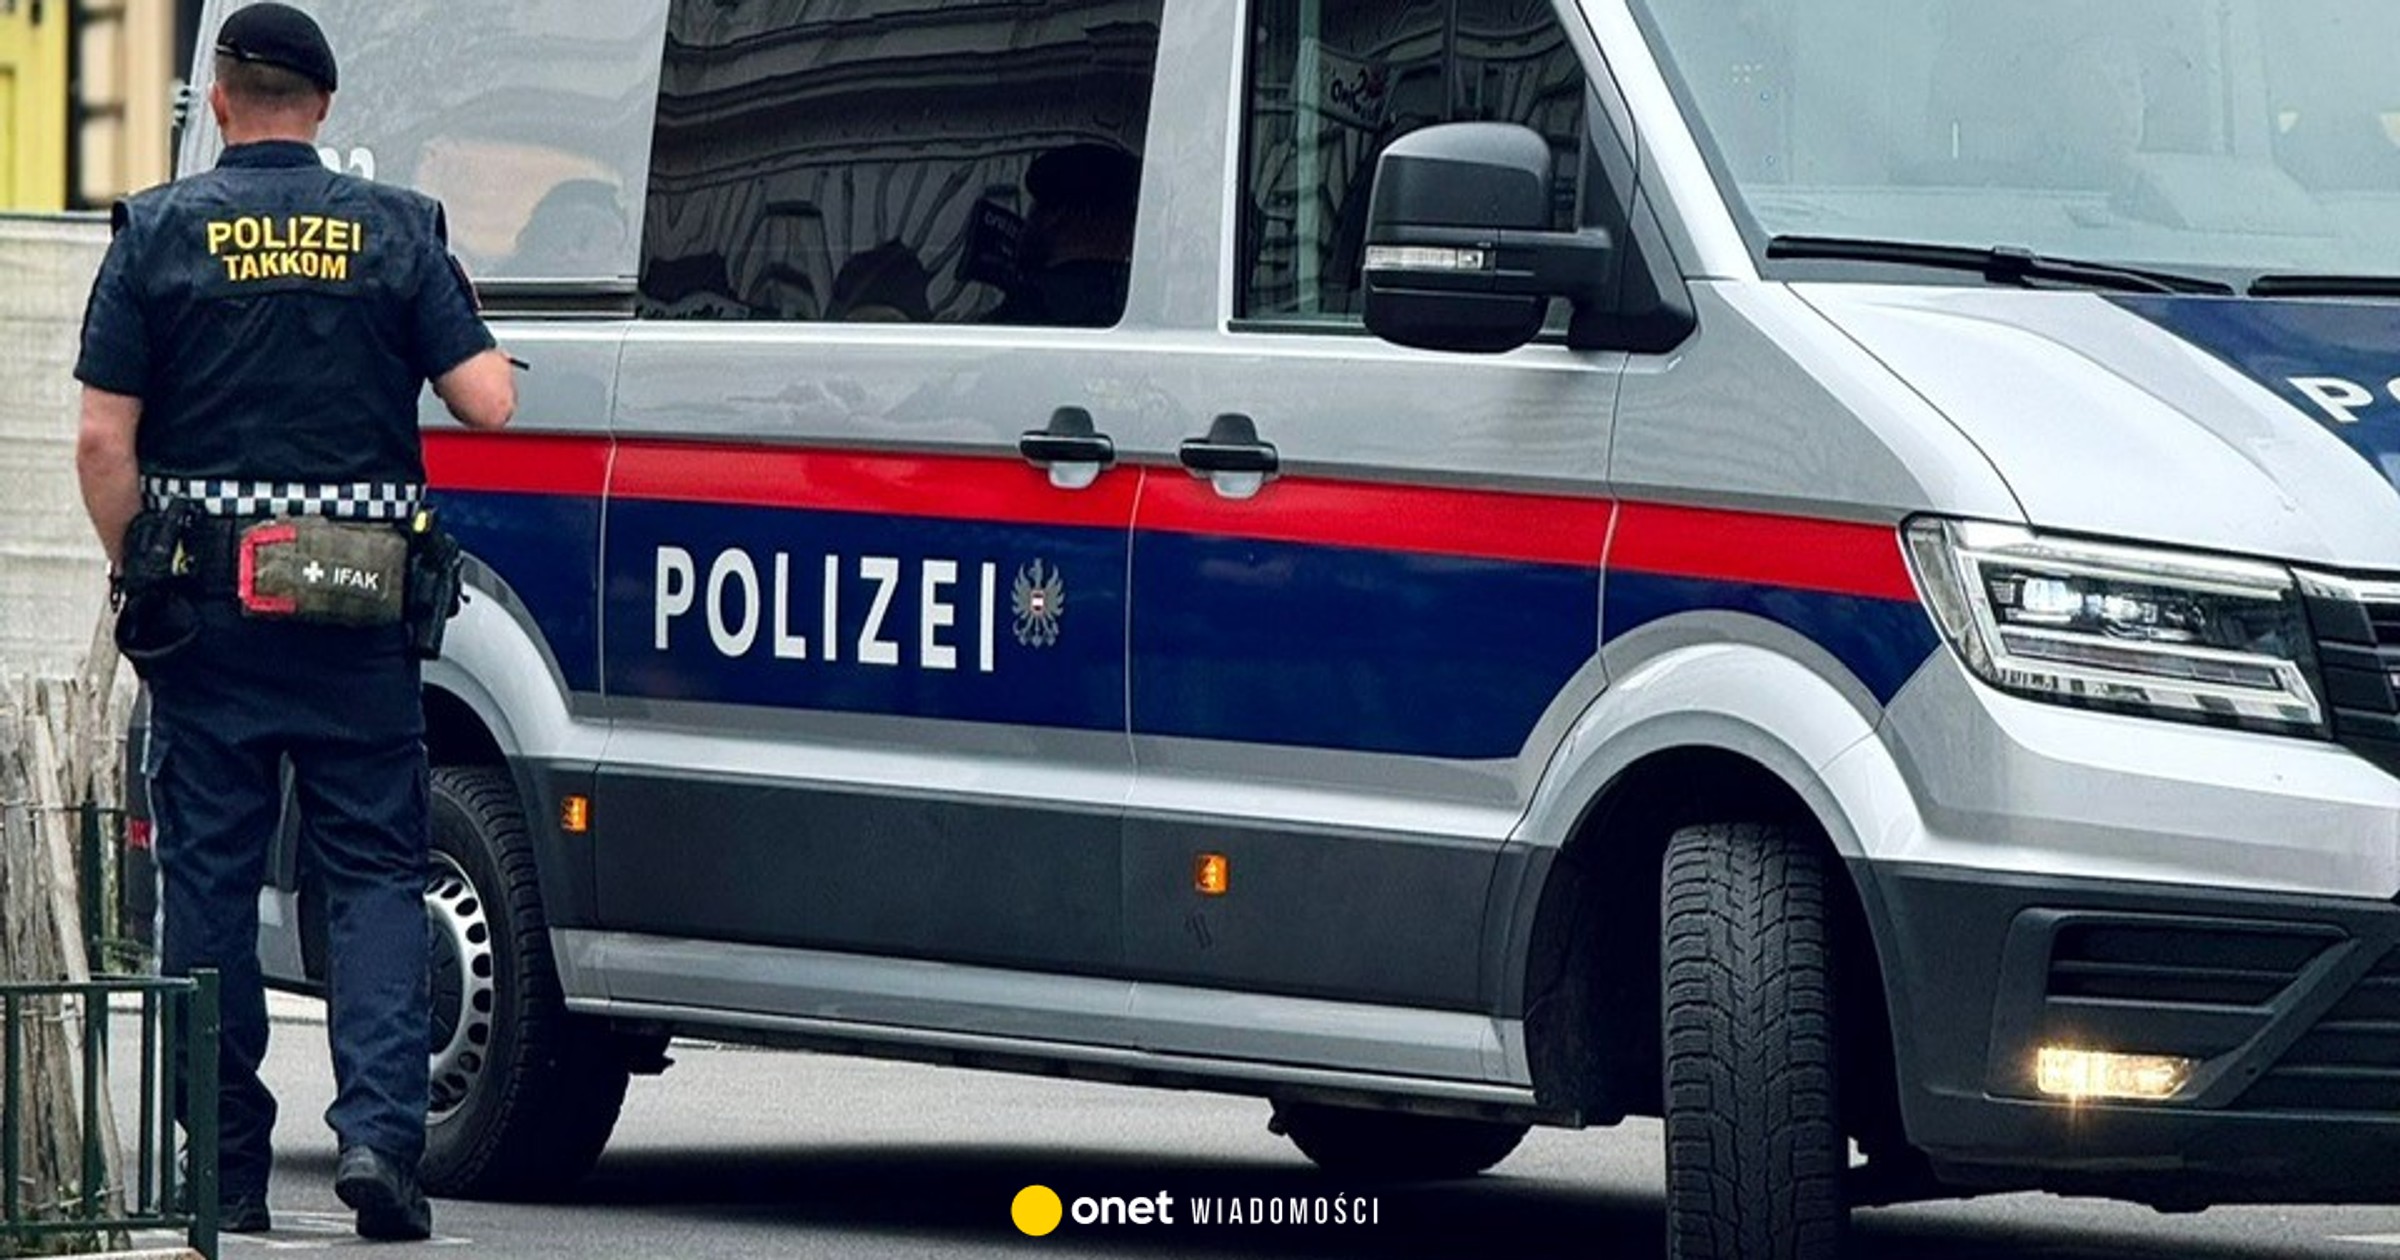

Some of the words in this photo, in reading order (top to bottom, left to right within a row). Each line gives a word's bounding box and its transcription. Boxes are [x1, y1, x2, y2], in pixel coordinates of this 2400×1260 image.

[207, 215, 361, 255] POLIZEI
[222, 251, 347, 281] TAKKOM
[333, 567, 379, 591] IFAK
[655, 546, 996, 672] POLIZEI
